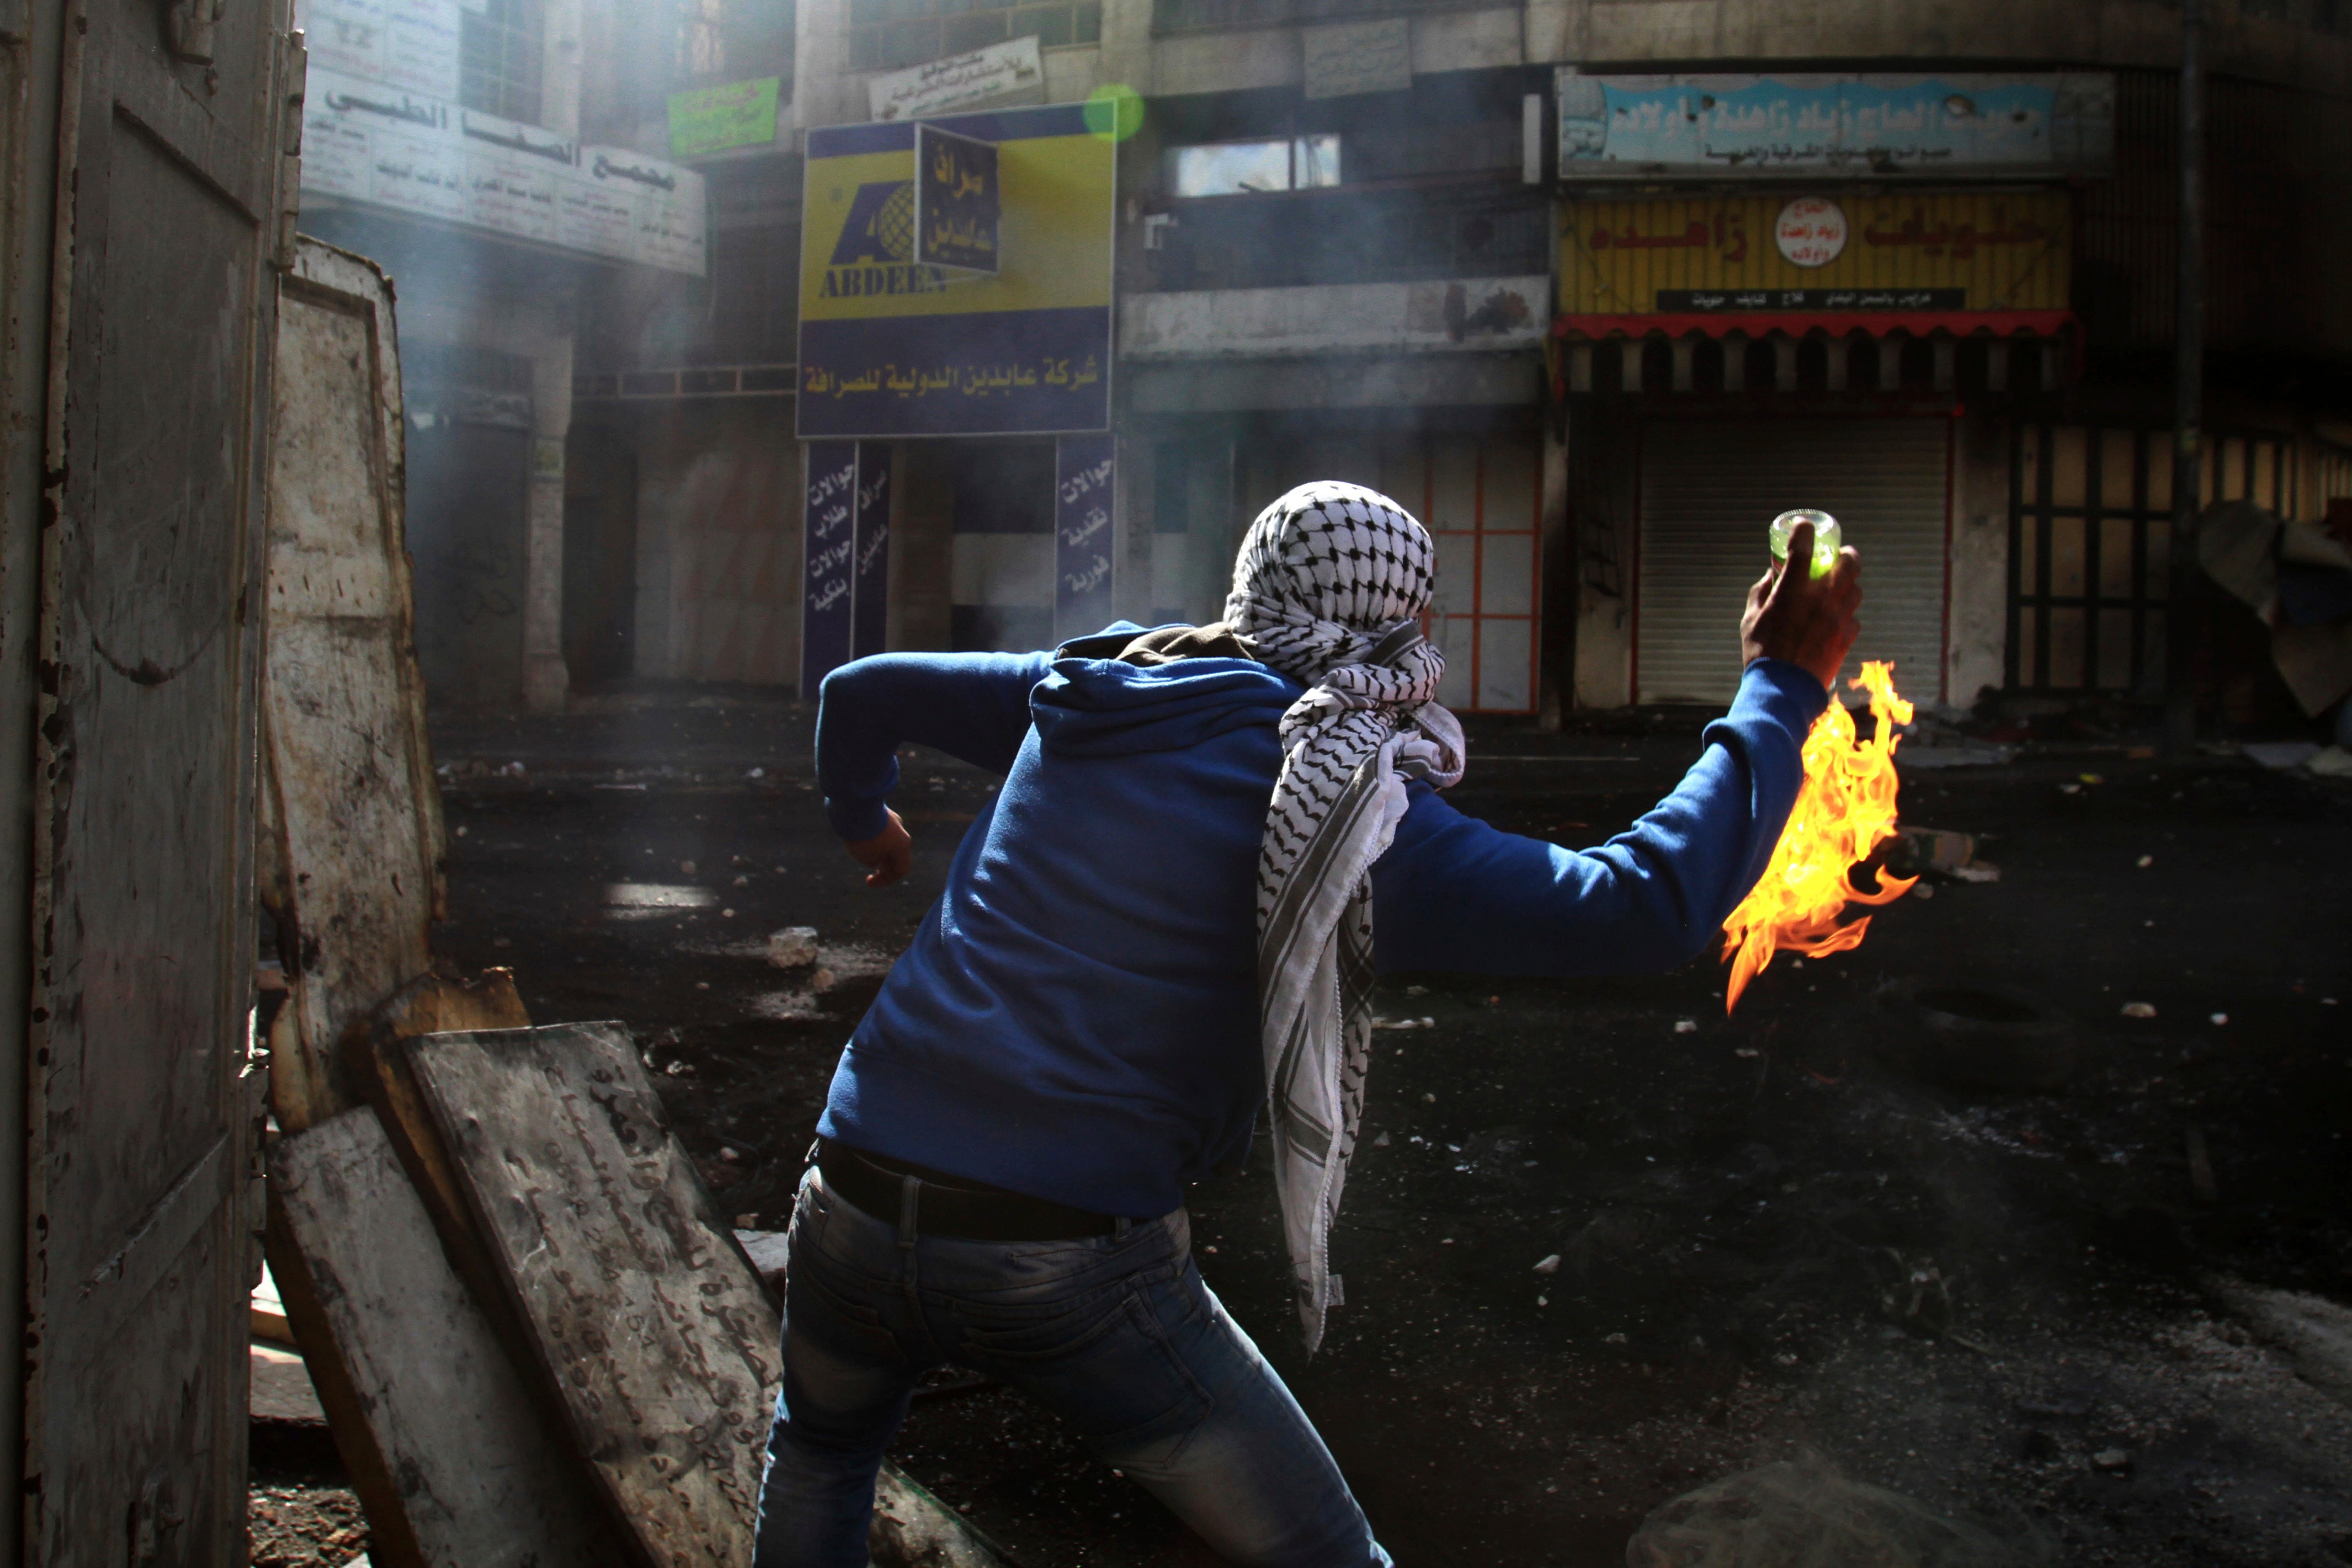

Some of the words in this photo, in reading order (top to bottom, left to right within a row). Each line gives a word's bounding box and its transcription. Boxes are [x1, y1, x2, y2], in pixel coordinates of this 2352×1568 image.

[324, 90, 448, 130] الطبي
[820, 264, 948, 298] ABDEEN
[805, 366, 880, 399] للصرافة
[885, 362, 959, 398] الدولية
[962, 364, 1037, 396] عابدين
[1043, 355, 1097, 392] شركة
[808, 464, 854, 506] حوالات
[1061, 459, 1113, 504] حوالات
[813, 505, 848, 539] طلاب
[1061, 507, 1108, 546] نقدية
[809, 540, 851, 578] حوالات
[1065, 553, 1109, 593] فورية
[808, 578, 851, 611] بنكية
[696, 1271, 786, 1391] لصخرة
